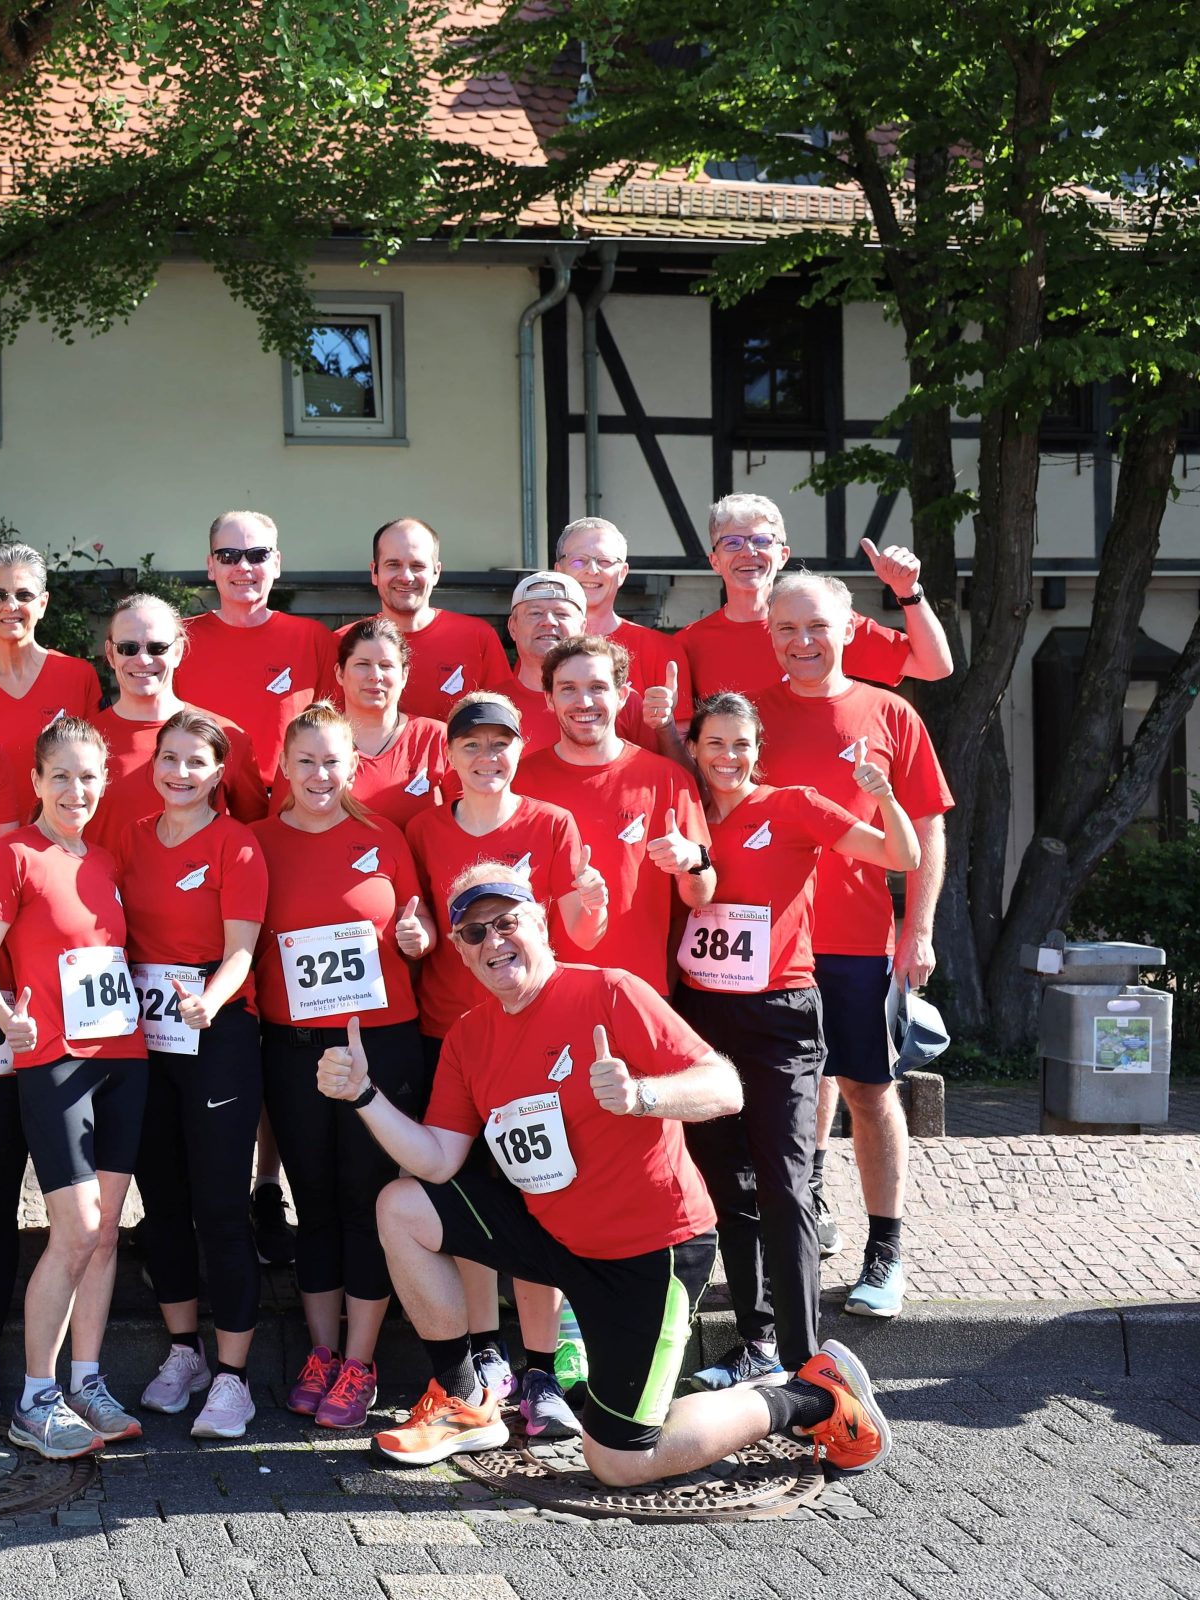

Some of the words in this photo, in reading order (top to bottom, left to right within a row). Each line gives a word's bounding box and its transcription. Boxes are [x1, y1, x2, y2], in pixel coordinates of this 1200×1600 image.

[728, 911, 769, 920] Kreisblatt
[690, 927, 754, 962] 384
[295, 947, 366, 989] 325
[688, 969, 719, 978] Frankfurter
[720, 972, 754, 981] Volksbank
[79, 972, 131, 1008] 184
[300, 998, 336, 1008] Frankfurter
[337, 992, 372, 1002] Volksbank
[155, 1034, 186, 1042] Volksbank
[552, 1054, 568, 1078] Altenhain
[518, 1100, 558, 1114] Kreisblatt
[495, 1123, 552, 1165] 185
[531, 1171, 564, 1182] Volksbank
